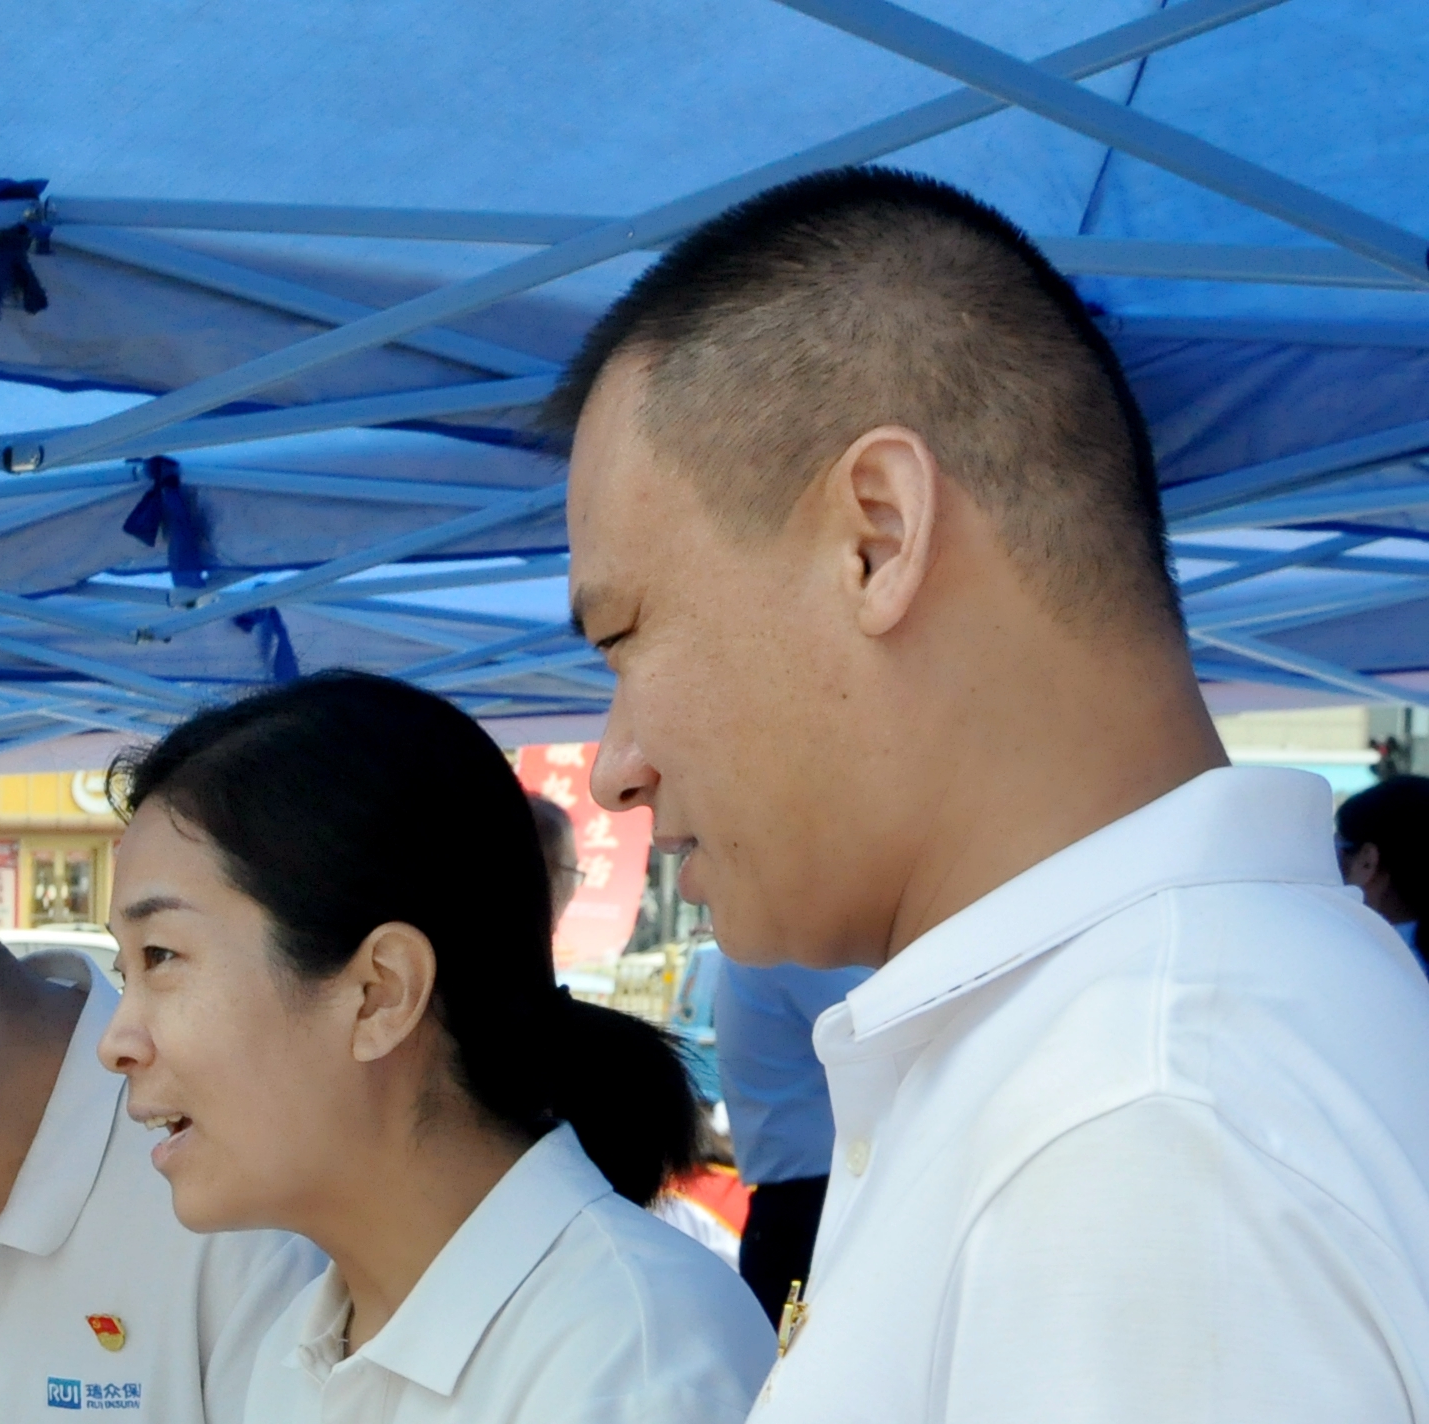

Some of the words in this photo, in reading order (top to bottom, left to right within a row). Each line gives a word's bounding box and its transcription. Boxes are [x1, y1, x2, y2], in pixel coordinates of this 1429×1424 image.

[48, 1382, 79, 1404] RUI
[85, 1383, 142, 1399] 瑞众保
